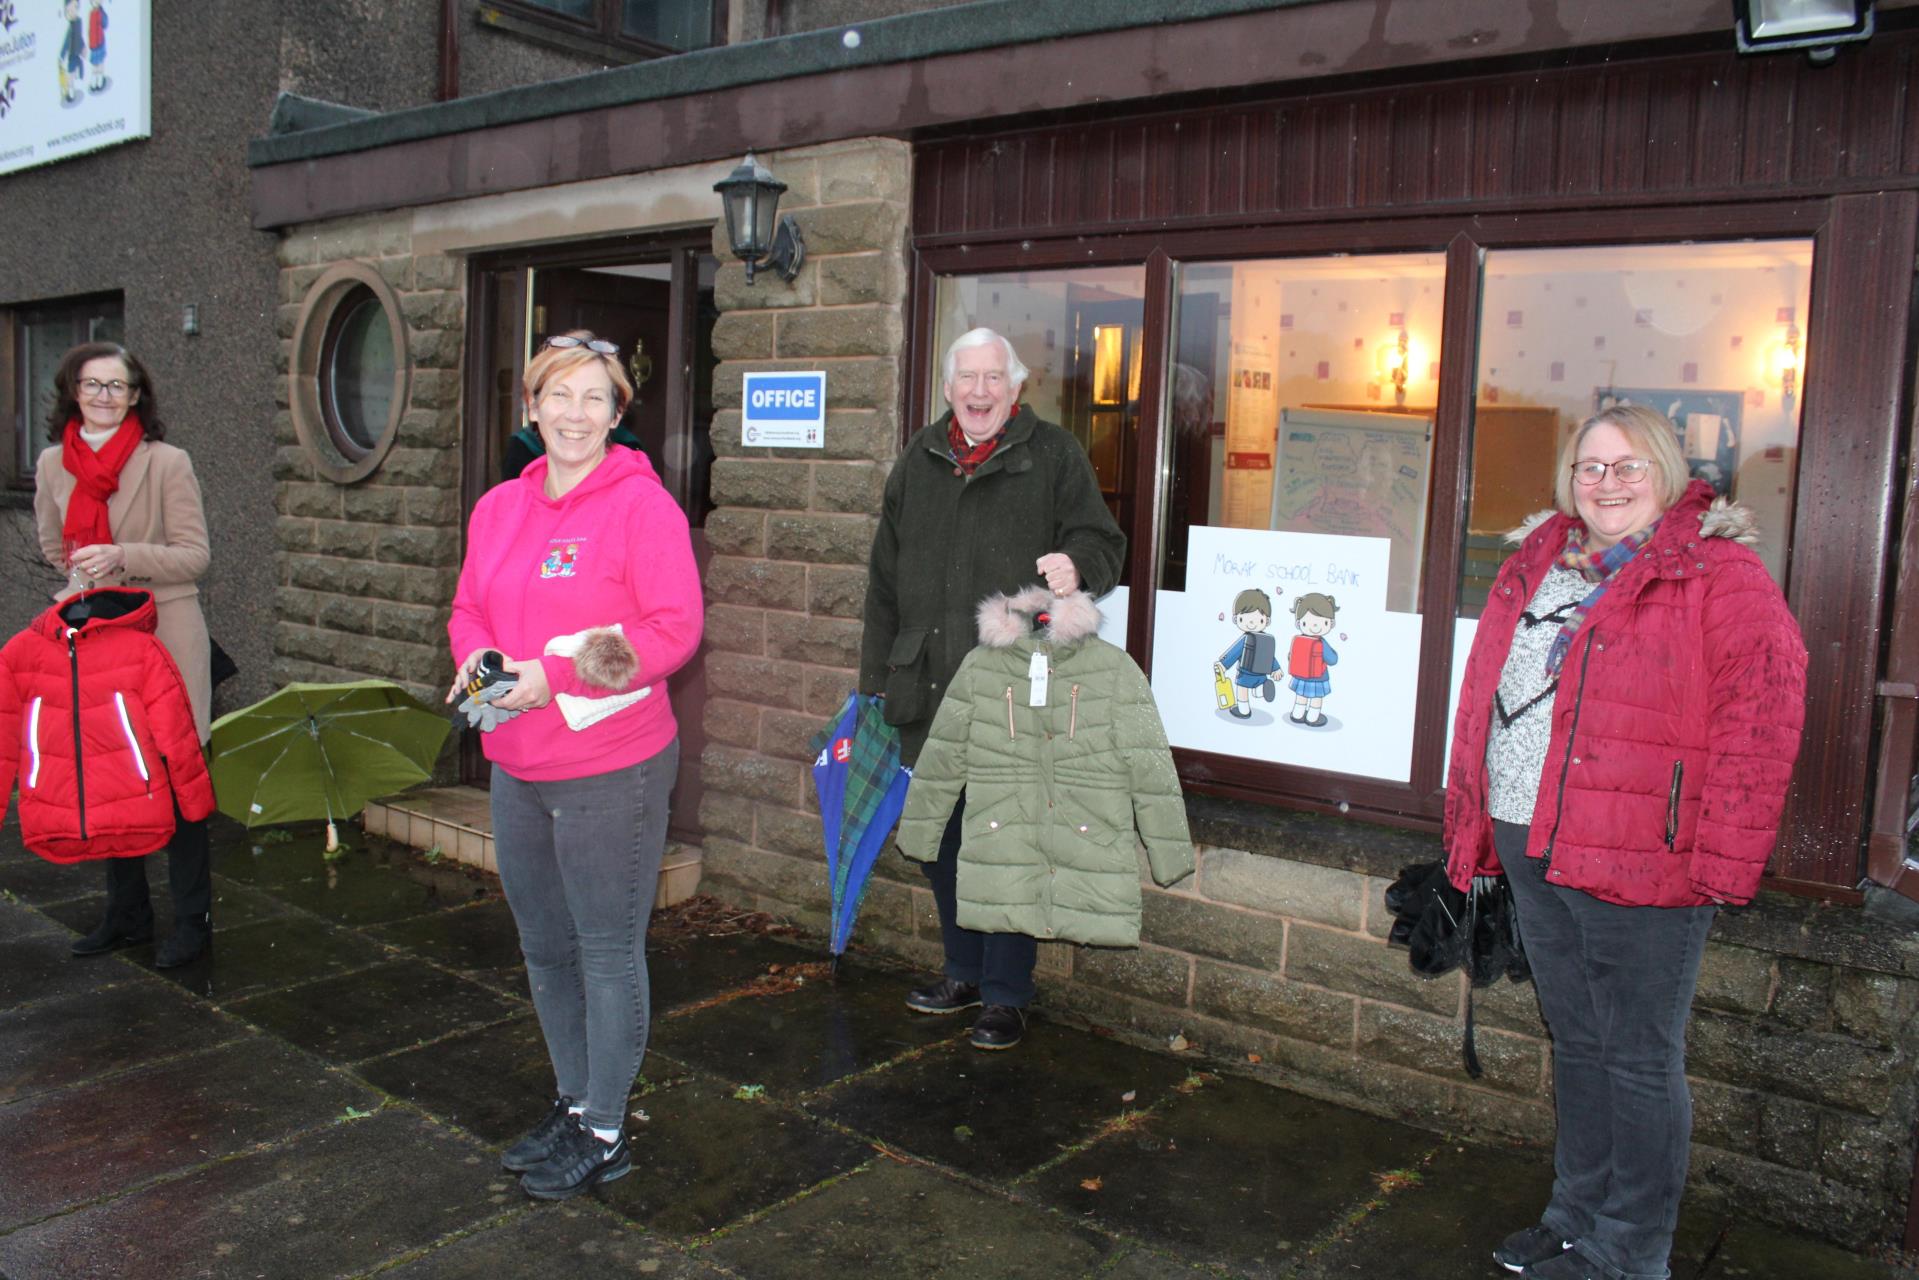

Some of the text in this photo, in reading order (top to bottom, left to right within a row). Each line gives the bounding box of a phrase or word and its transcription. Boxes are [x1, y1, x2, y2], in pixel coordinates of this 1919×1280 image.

[751, 389, 816, 408] OFFICE
[1265, 563, 1318, 585] SCHOOL
[1325, 562, 1360, 588] BANK
